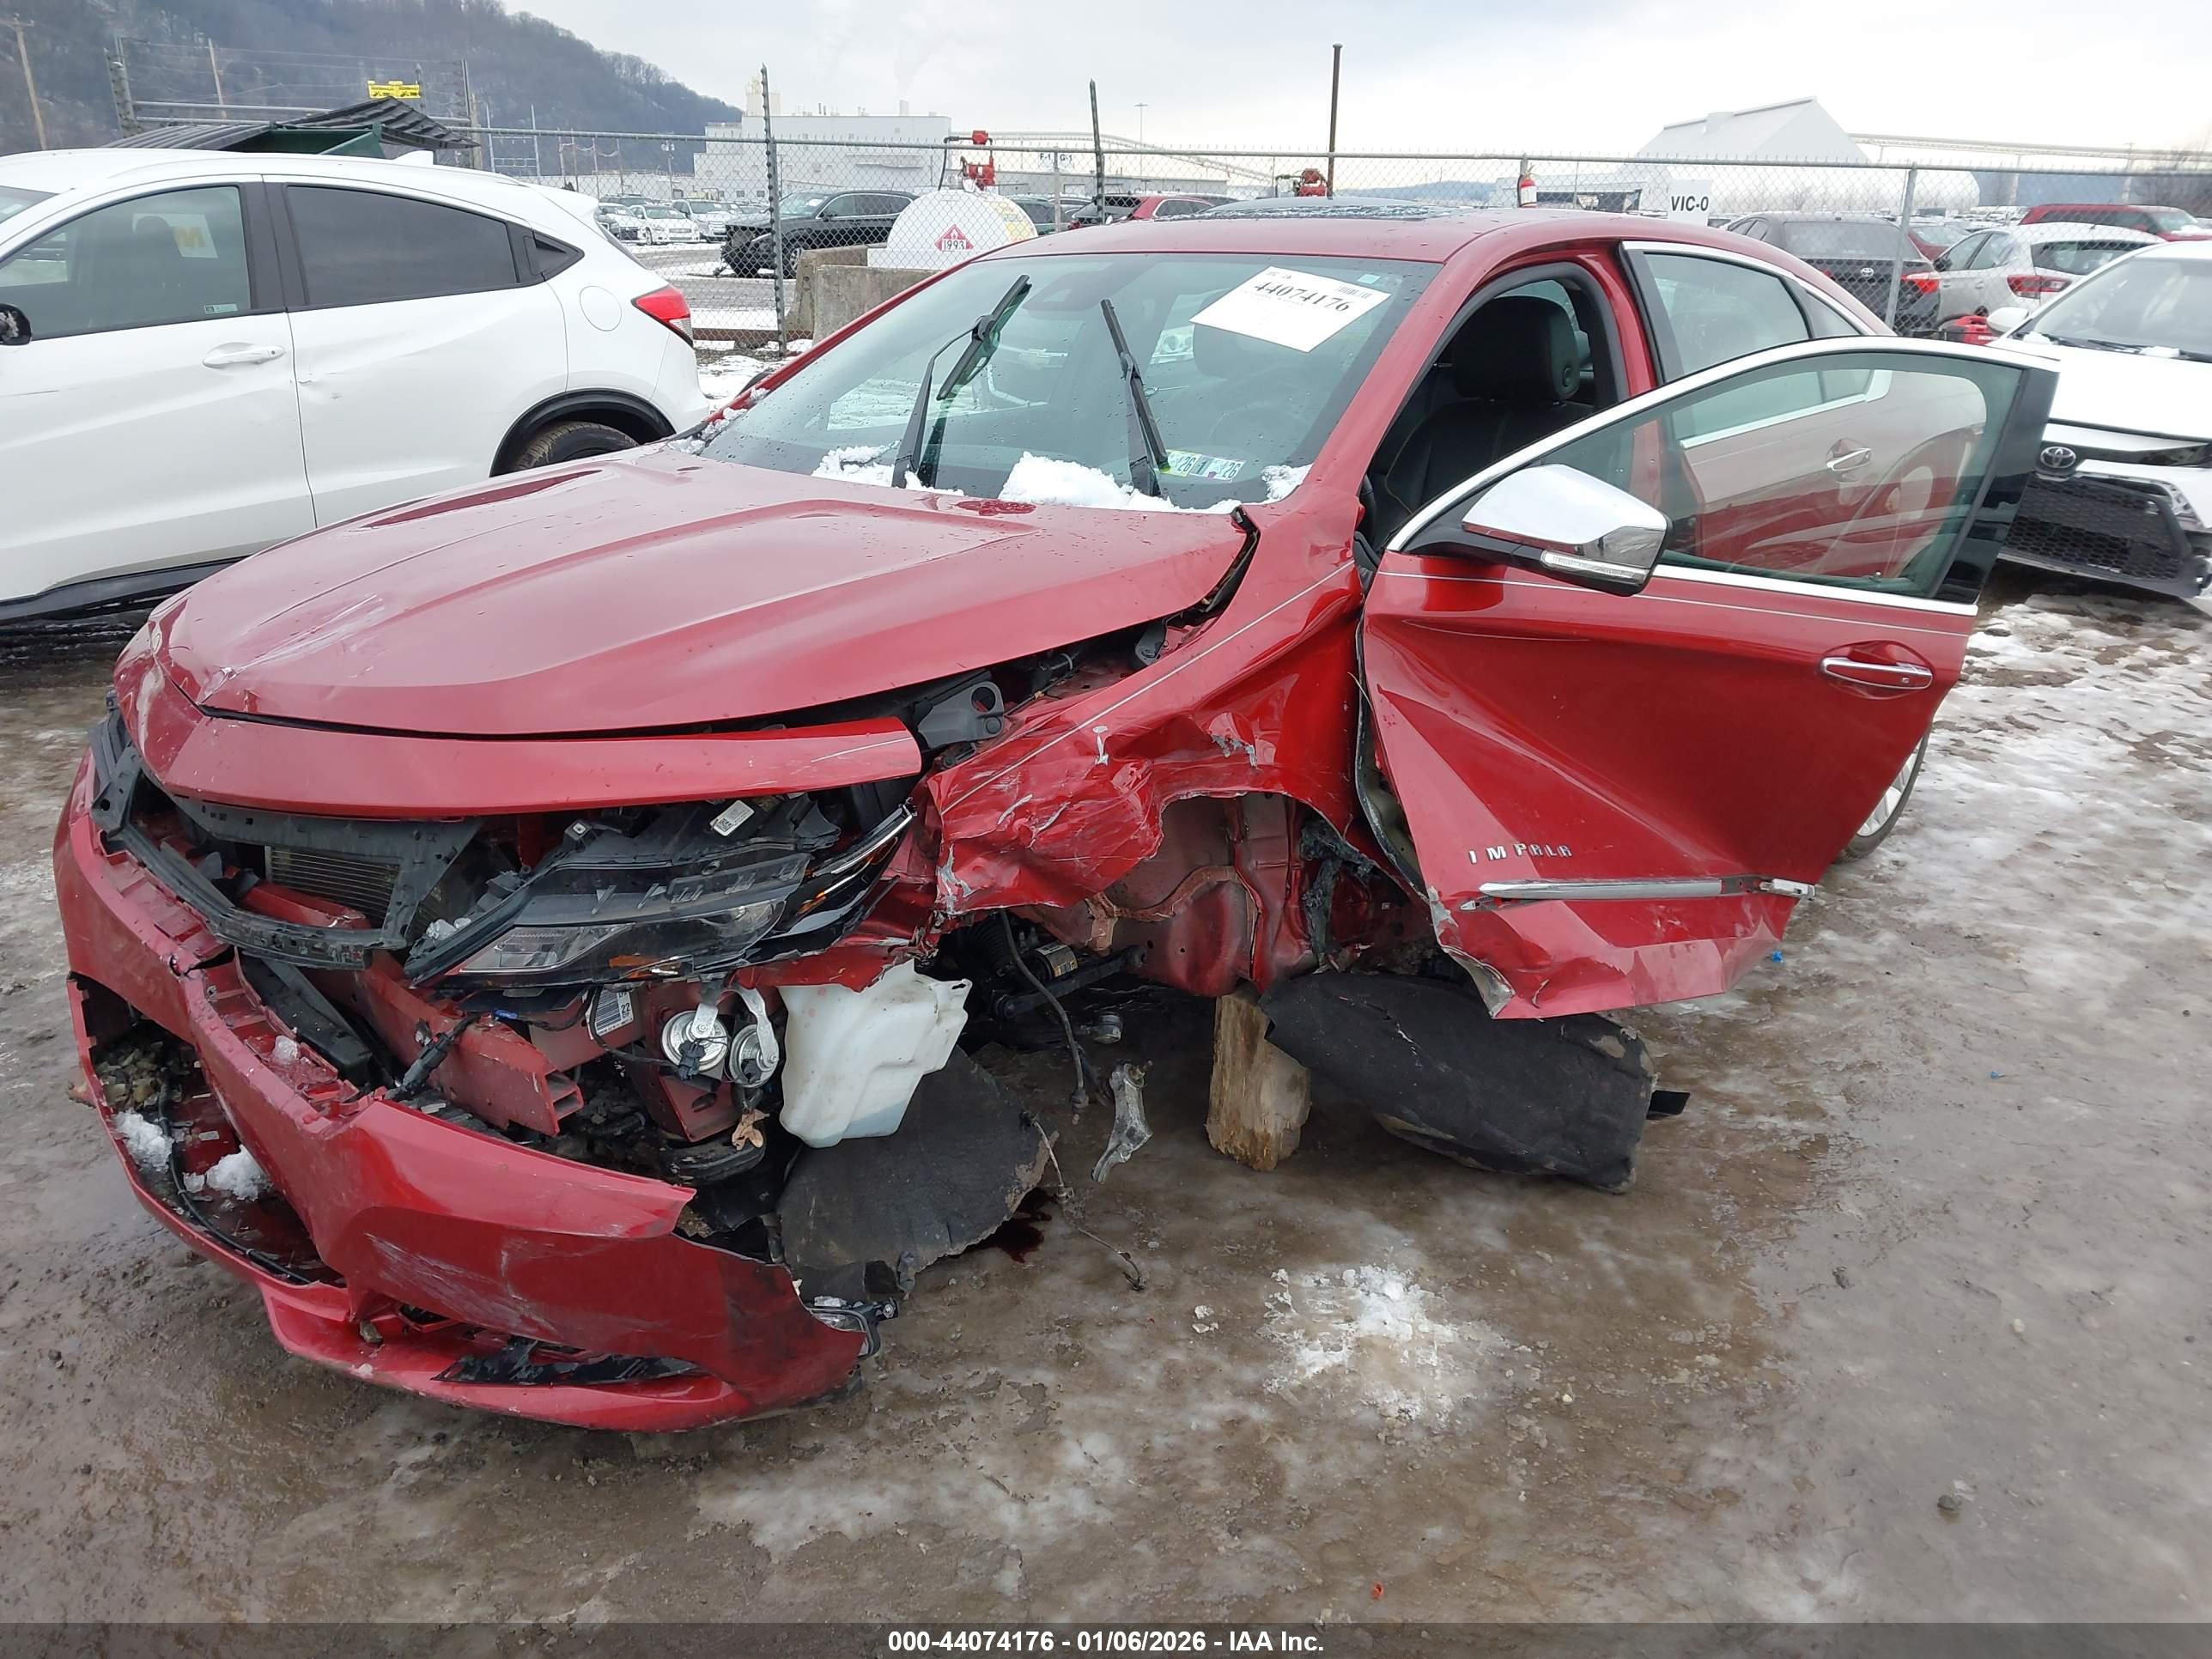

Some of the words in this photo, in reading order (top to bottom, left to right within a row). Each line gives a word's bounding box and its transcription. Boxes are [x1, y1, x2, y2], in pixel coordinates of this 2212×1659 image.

[944, 240, 965, 250] 1993
[1255, 282, 1352, 312] 44074176
[1176, 456, 1196, 472] 26
[1223, 462, 1242, 478] 26
[1468, 842, 1573, 865] IMPALA
